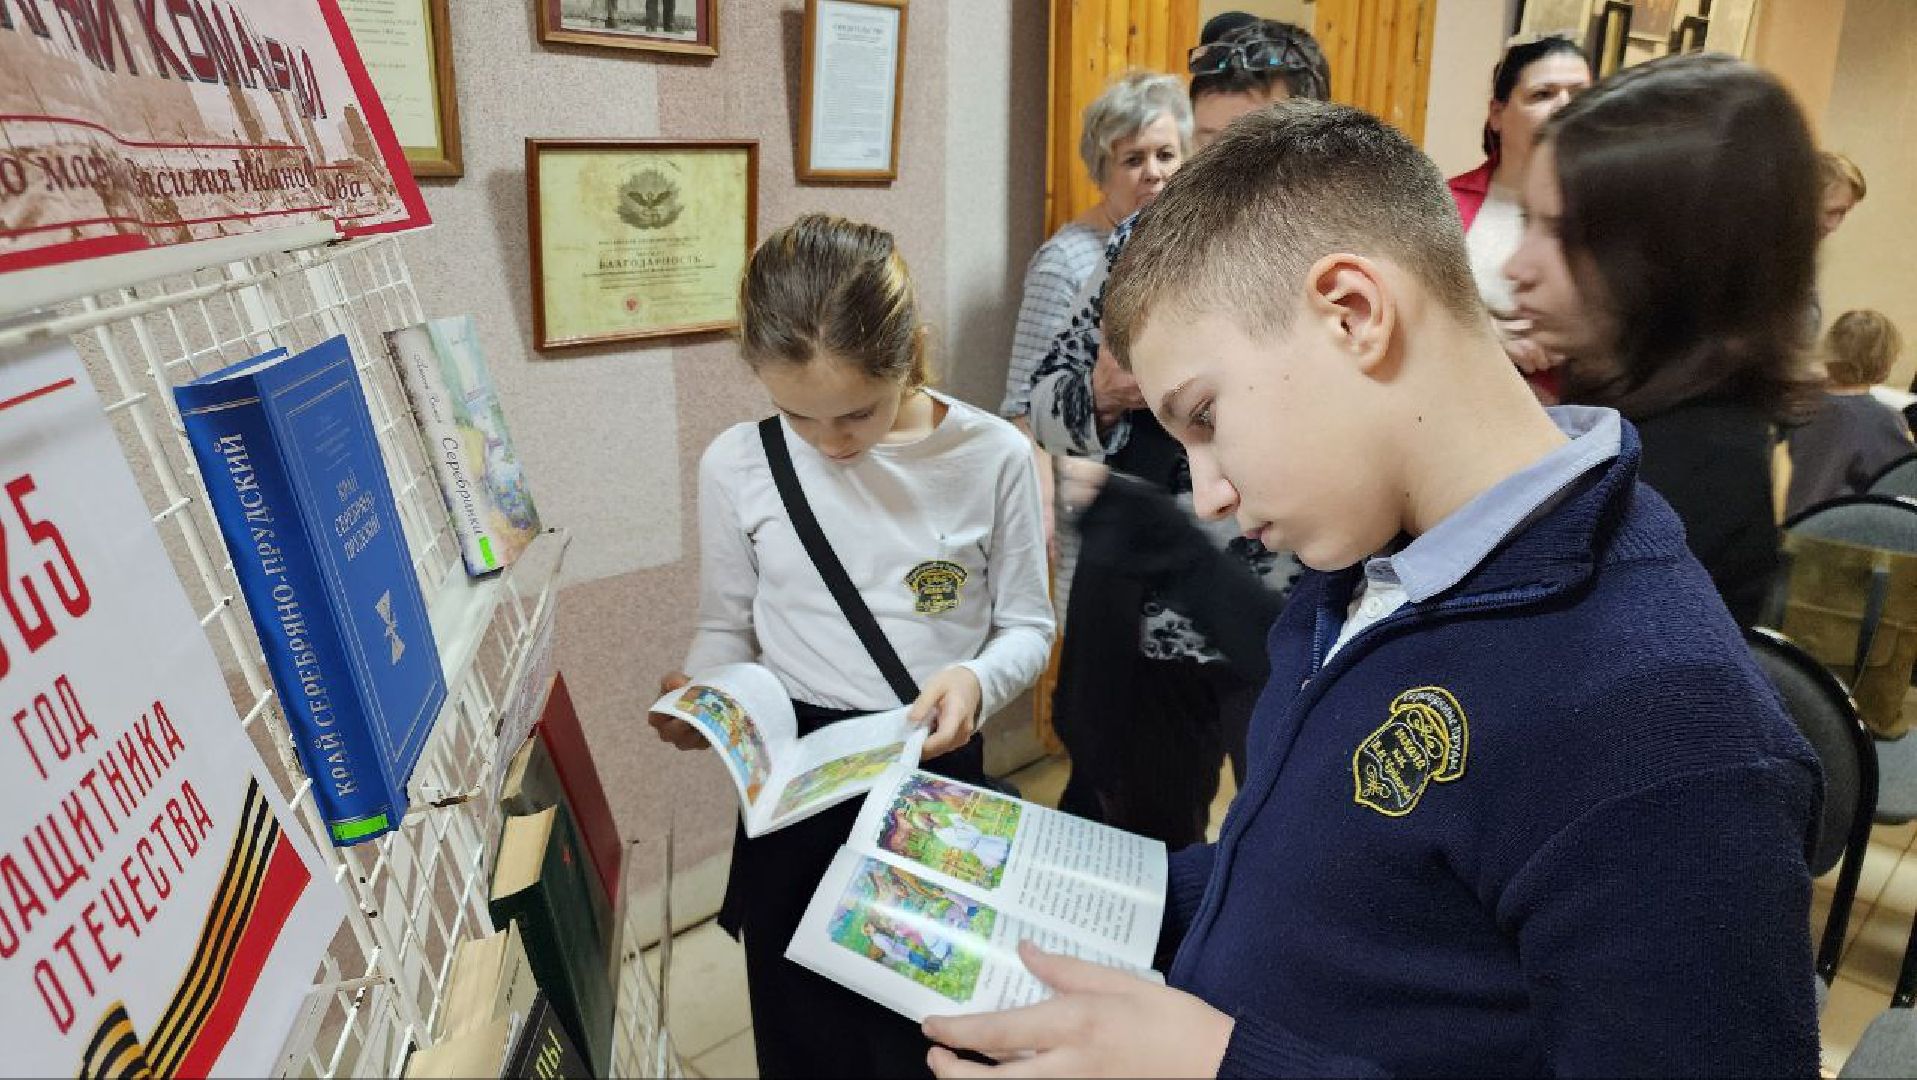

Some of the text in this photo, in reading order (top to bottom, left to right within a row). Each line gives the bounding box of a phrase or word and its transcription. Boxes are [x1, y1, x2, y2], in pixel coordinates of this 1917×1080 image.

[12, 674, 98, 780] ГОД
[315, 736, 359, 797] КРАЙ
[34, 780, 214, 1035] ОТЕЧЕСТВА
